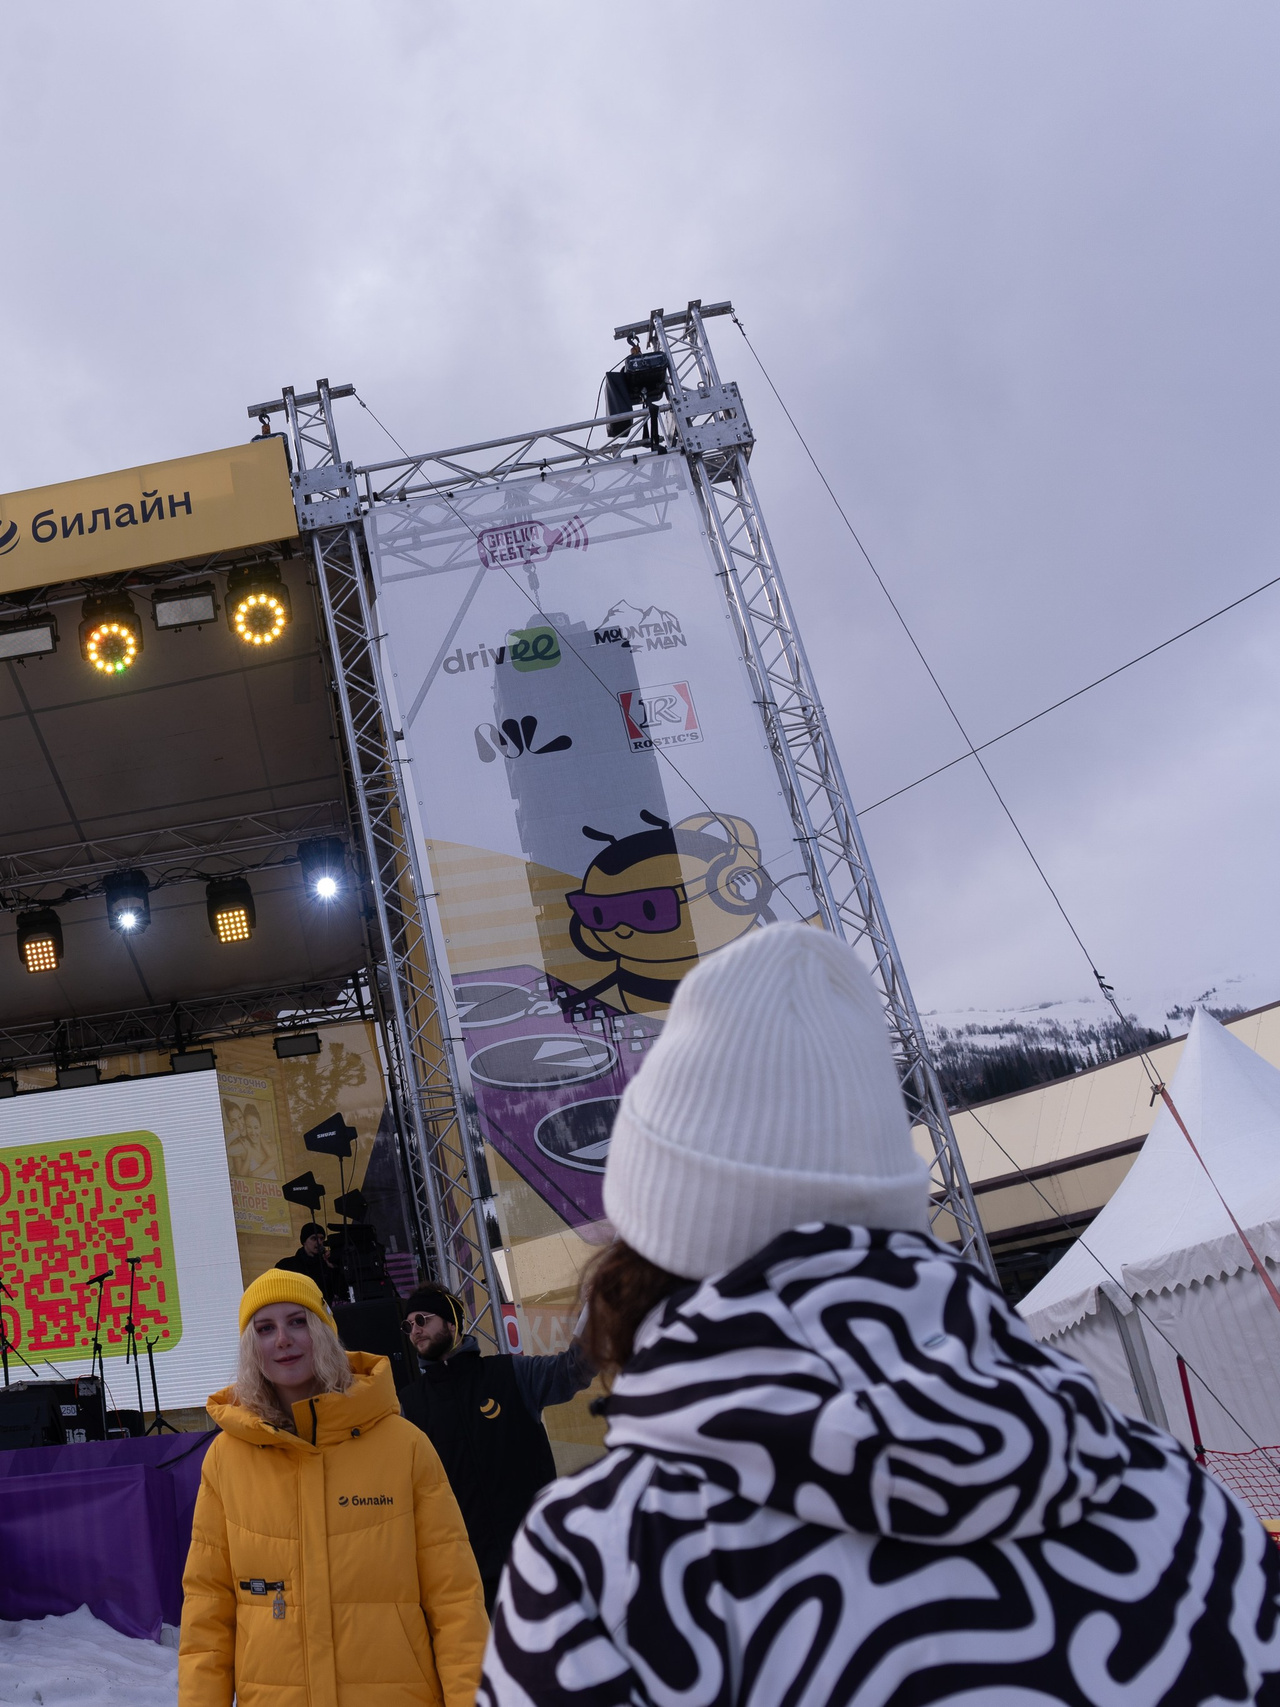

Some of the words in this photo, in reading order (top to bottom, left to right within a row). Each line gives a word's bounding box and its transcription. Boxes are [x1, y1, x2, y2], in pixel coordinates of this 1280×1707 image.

[31, 490, 193, 544] билайн
[487, 526, 539, 549] GRELKA
[490, 545, 525, 563] FEST
[593, 620, 682, 645] MOUNTAIN
[646, 634, 688, 651] MAN
[442, 634, 561, 675] drivee
[632, 732, 699, 750] ROSTIC'S
[254, 1182, 282, 1197] БАНЬ
[242, 1196, 269, 1210] ГОРЕ
[351, 1494, 394, 1506] билайн
